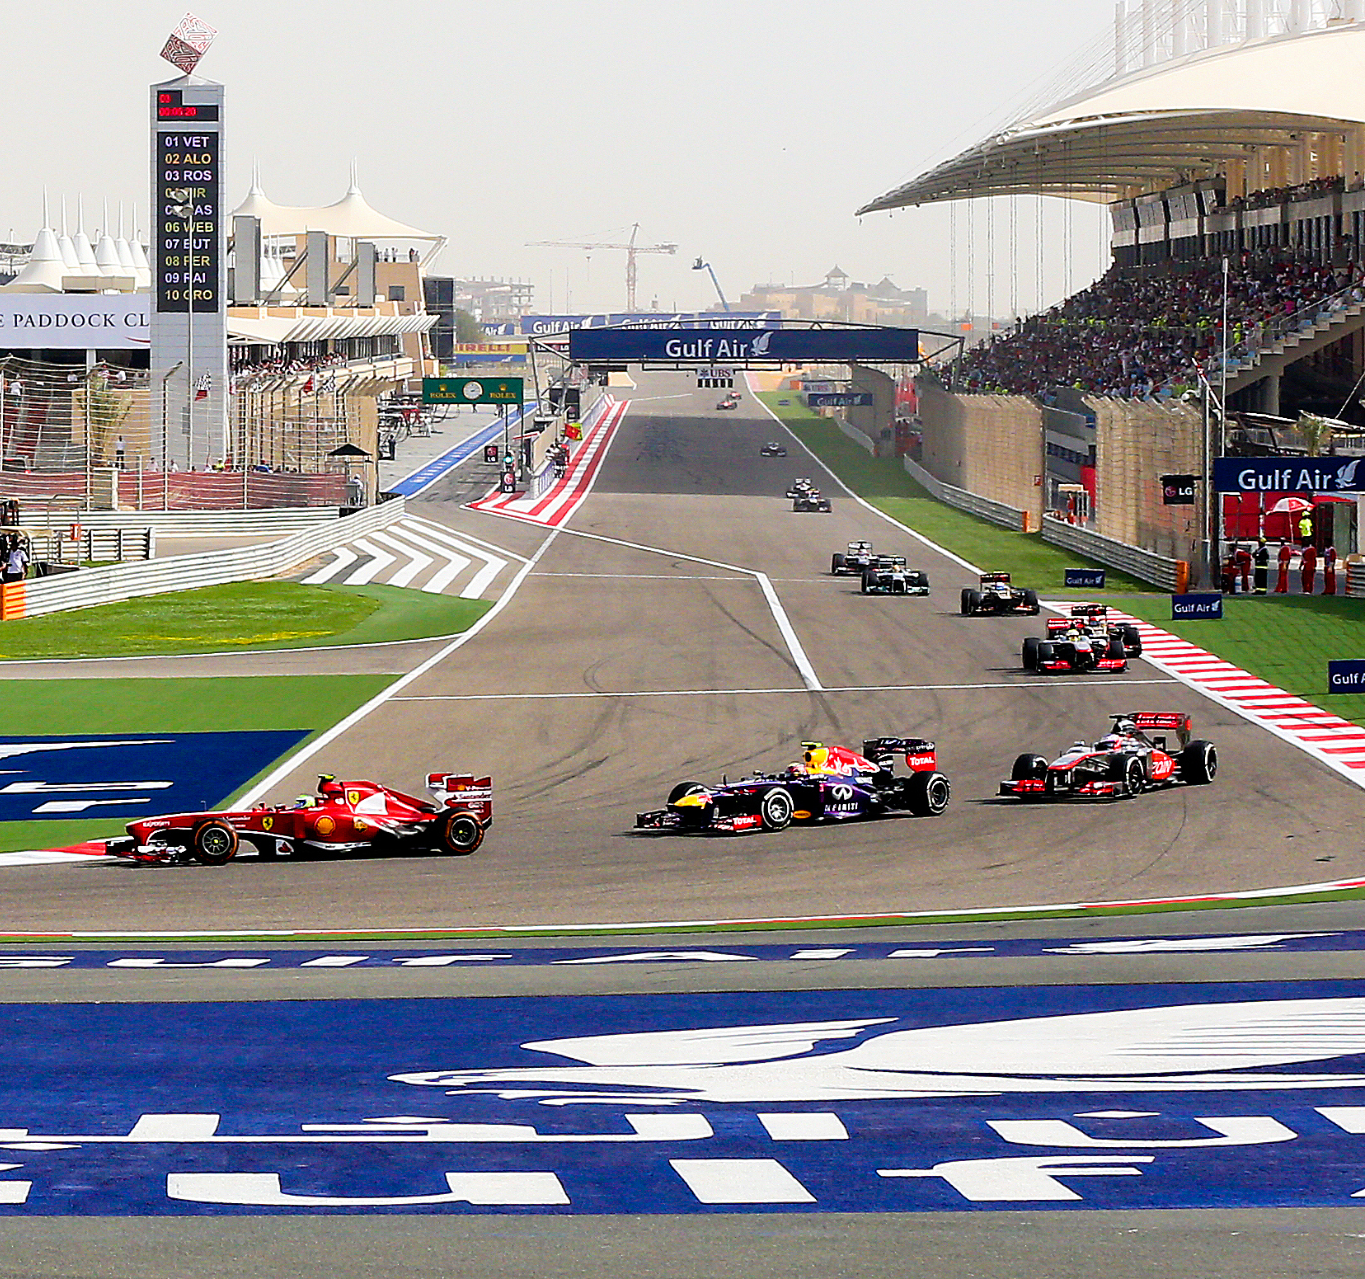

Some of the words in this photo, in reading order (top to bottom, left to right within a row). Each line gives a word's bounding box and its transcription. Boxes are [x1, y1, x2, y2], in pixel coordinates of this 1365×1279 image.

[165, 136, 178, 147] 01
[182, 136, 209, 147] VET
[165, 153, 180, 164] 02
[183, 153, 212, 164] ALO
[165, 170, 180, 181] 03
[183, 170, 212, 181] ROS
[165, 222, 180, 233] 06
[183, 222, 214, 233] WEB
[165, 239, 180, 249] 07
[165, 256, 180, 266] 08
[165, 272, 179, 283] 09
[165, 289, 180, 300] 10
[13, 312, 116, 328] PADDOCK
[124, 312, 150, 327] CL
[533, 321, 561, 333] Gulf
[562, 321, 581, 333] Air
[666, 338, 713, 358] Gulf
[717, 339, 748, 357] Air
[710, 369, 731, 377] UBS
[1238, 469, 1292, 489] Gulf
[1295, 469, 1332, 489] Air
[1178, 487, 1193, 496] LG
[1174, 603, 1195, 613] Gulf
[1196, 603, 1210, 612] Air
[1332, 673, 1359, 685] Gulf
[910, 756, 935, 766] TOTAL
[732, 816, 757, 826] TOTAL
[550, 947, 995, 965] Air
